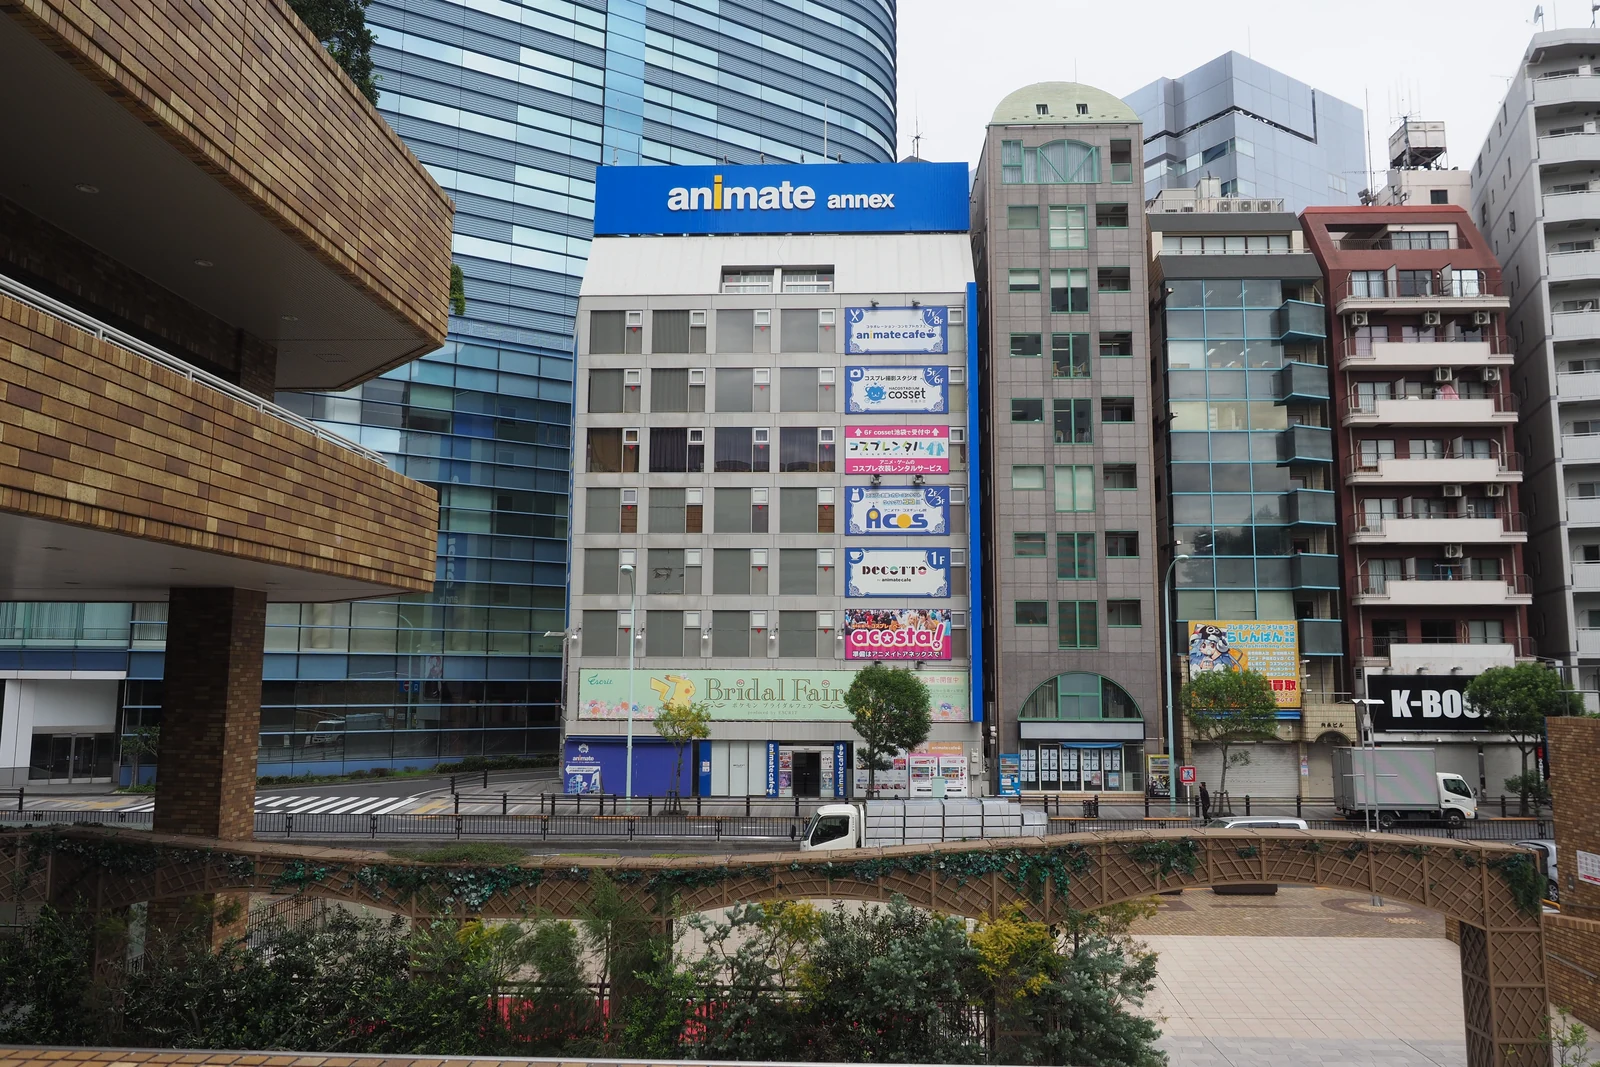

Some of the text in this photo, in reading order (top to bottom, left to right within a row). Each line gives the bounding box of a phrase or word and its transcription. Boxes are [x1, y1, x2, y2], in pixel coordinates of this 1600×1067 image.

[668, 175, 895, 210] animate annex
[888, 388, 926, 399] cosset
[850, 440, 924, 452] コスプレンタル
[1227, 631, 1283, 642] らしんばん
[704, 678, 844, 701] Bridal Fair
